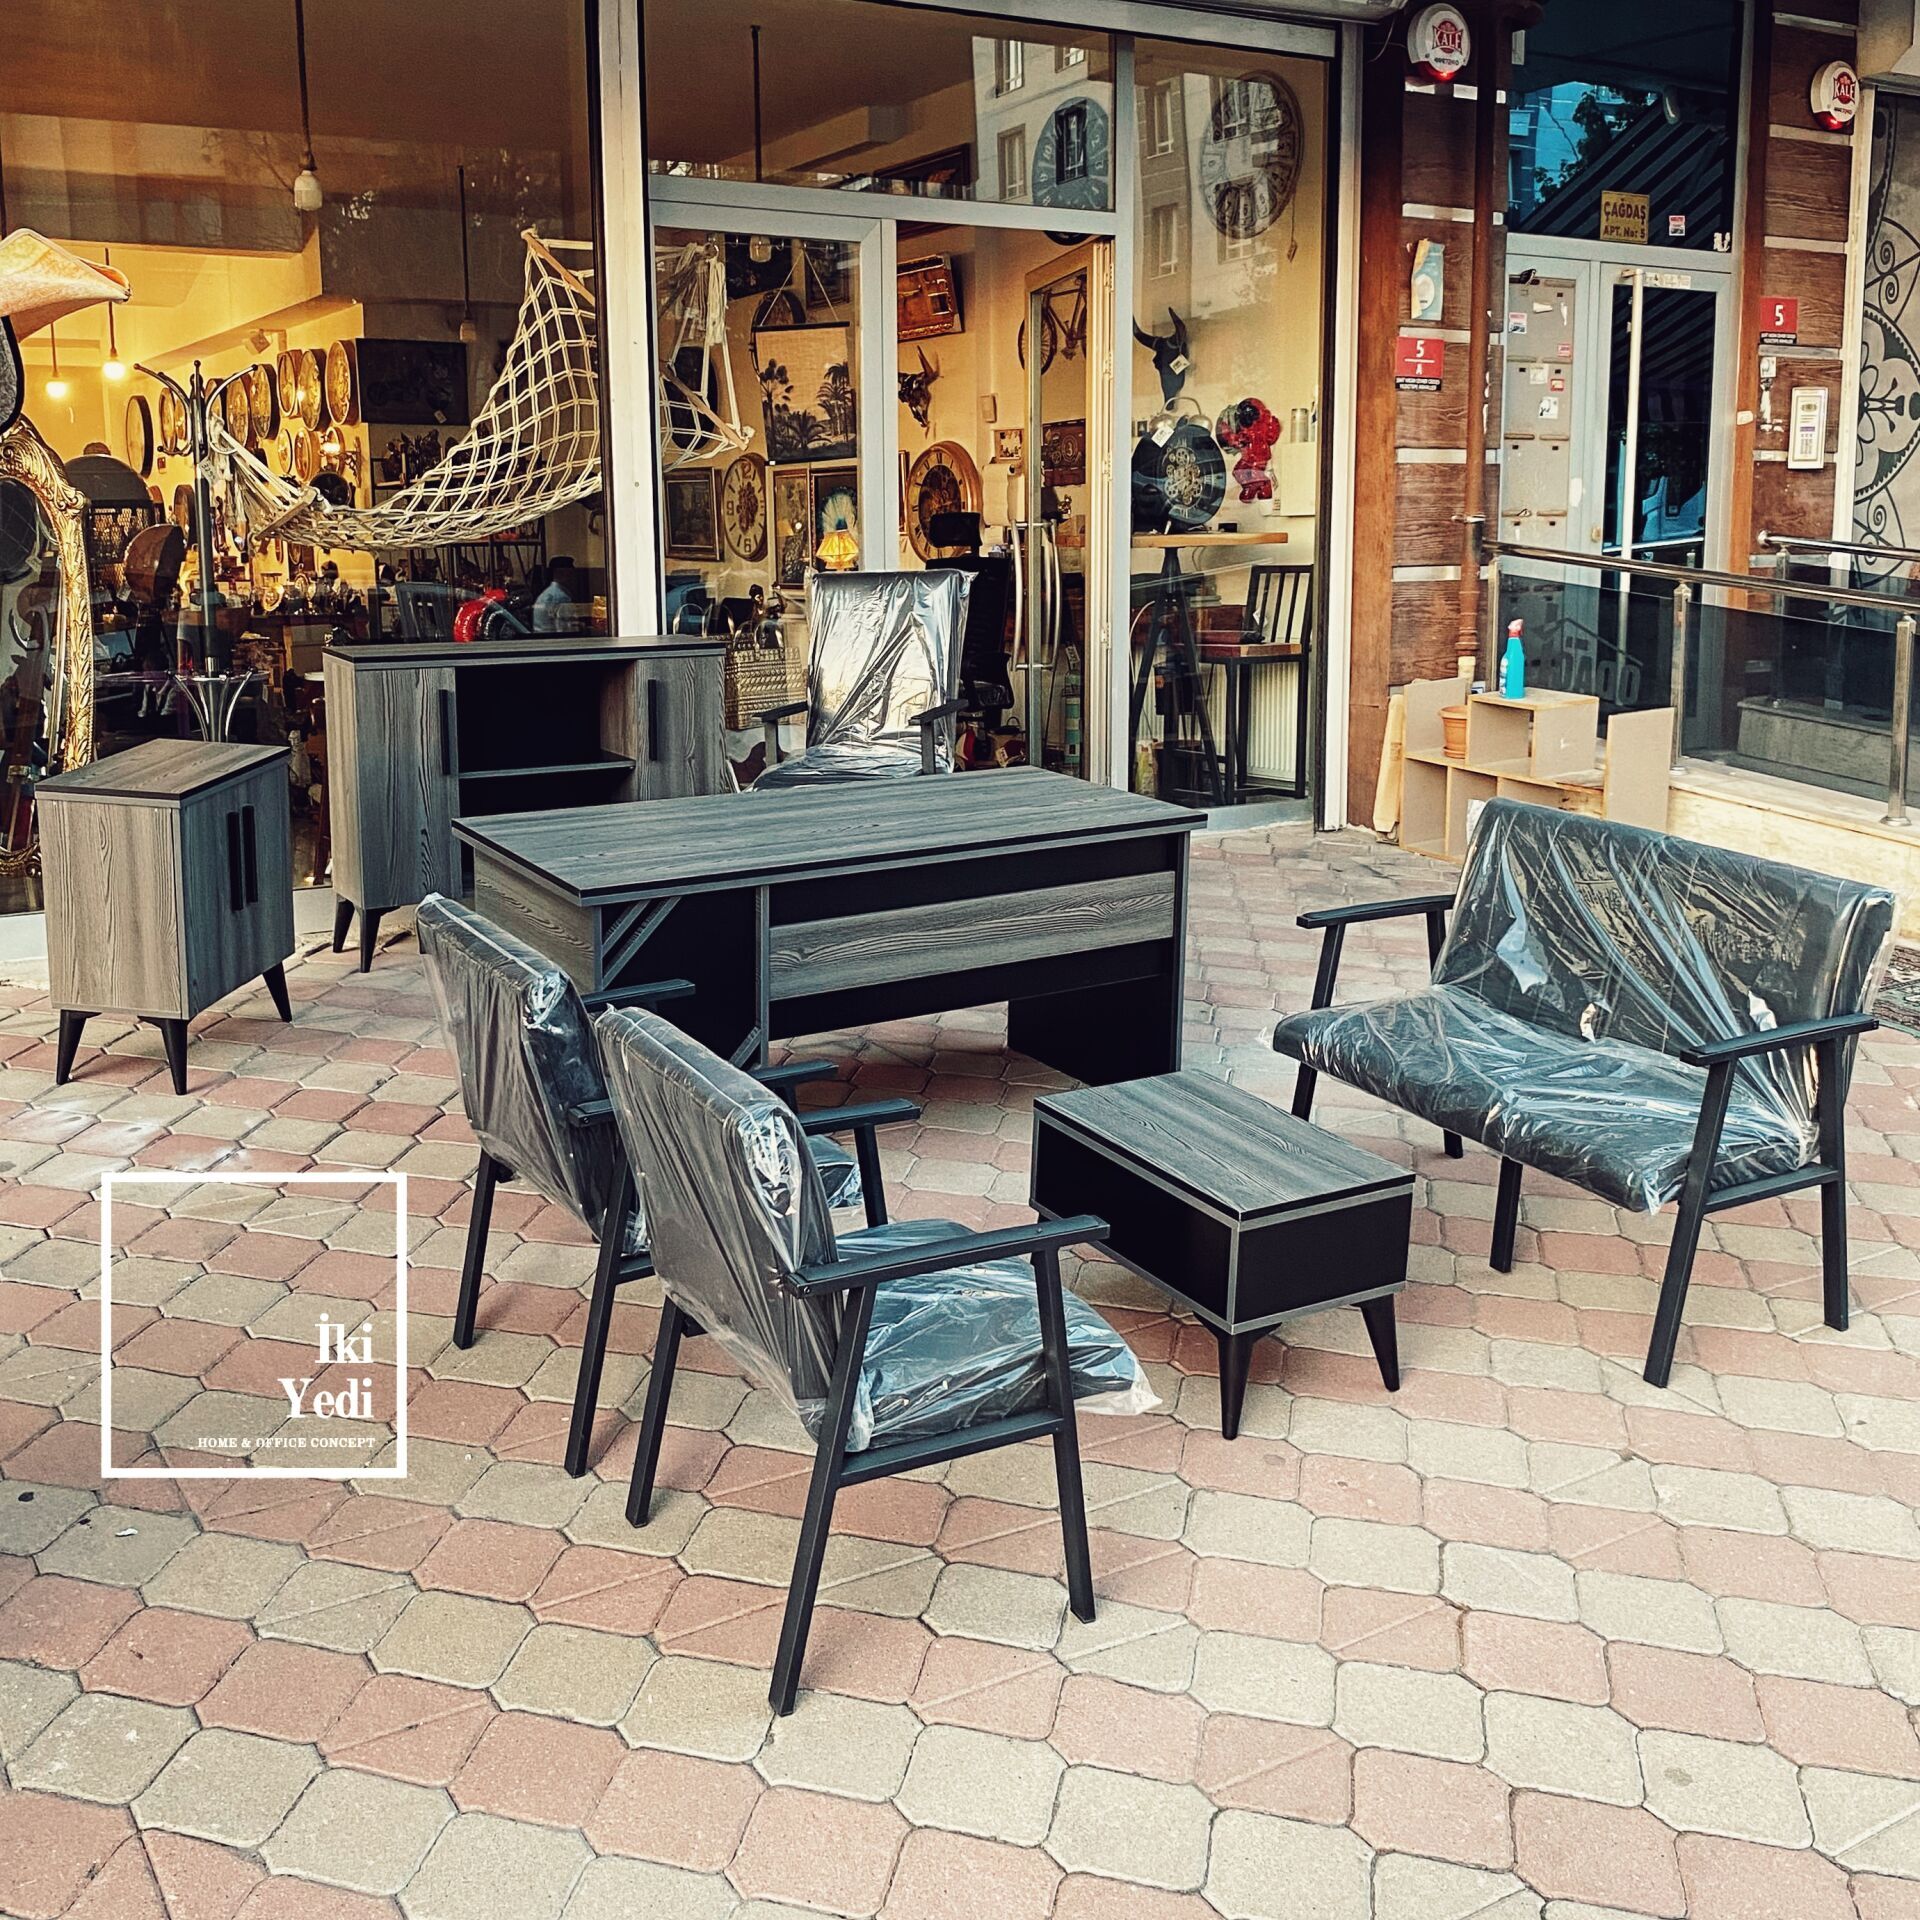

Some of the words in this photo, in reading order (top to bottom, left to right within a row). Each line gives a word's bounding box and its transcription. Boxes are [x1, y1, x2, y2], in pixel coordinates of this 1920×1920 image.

[1433, 28, 1462, 50] KALE
[1834, 79, 1855, 100] KALE
[1603, 198, 1646, 225] ÇAĞDAŞ
[1603, 225, 1621, 237] APT.
[1640, 228, 1646, 239] 5
[1774, 304, 1784, 326] 5
[1416, 340, 1424, 358] 5
